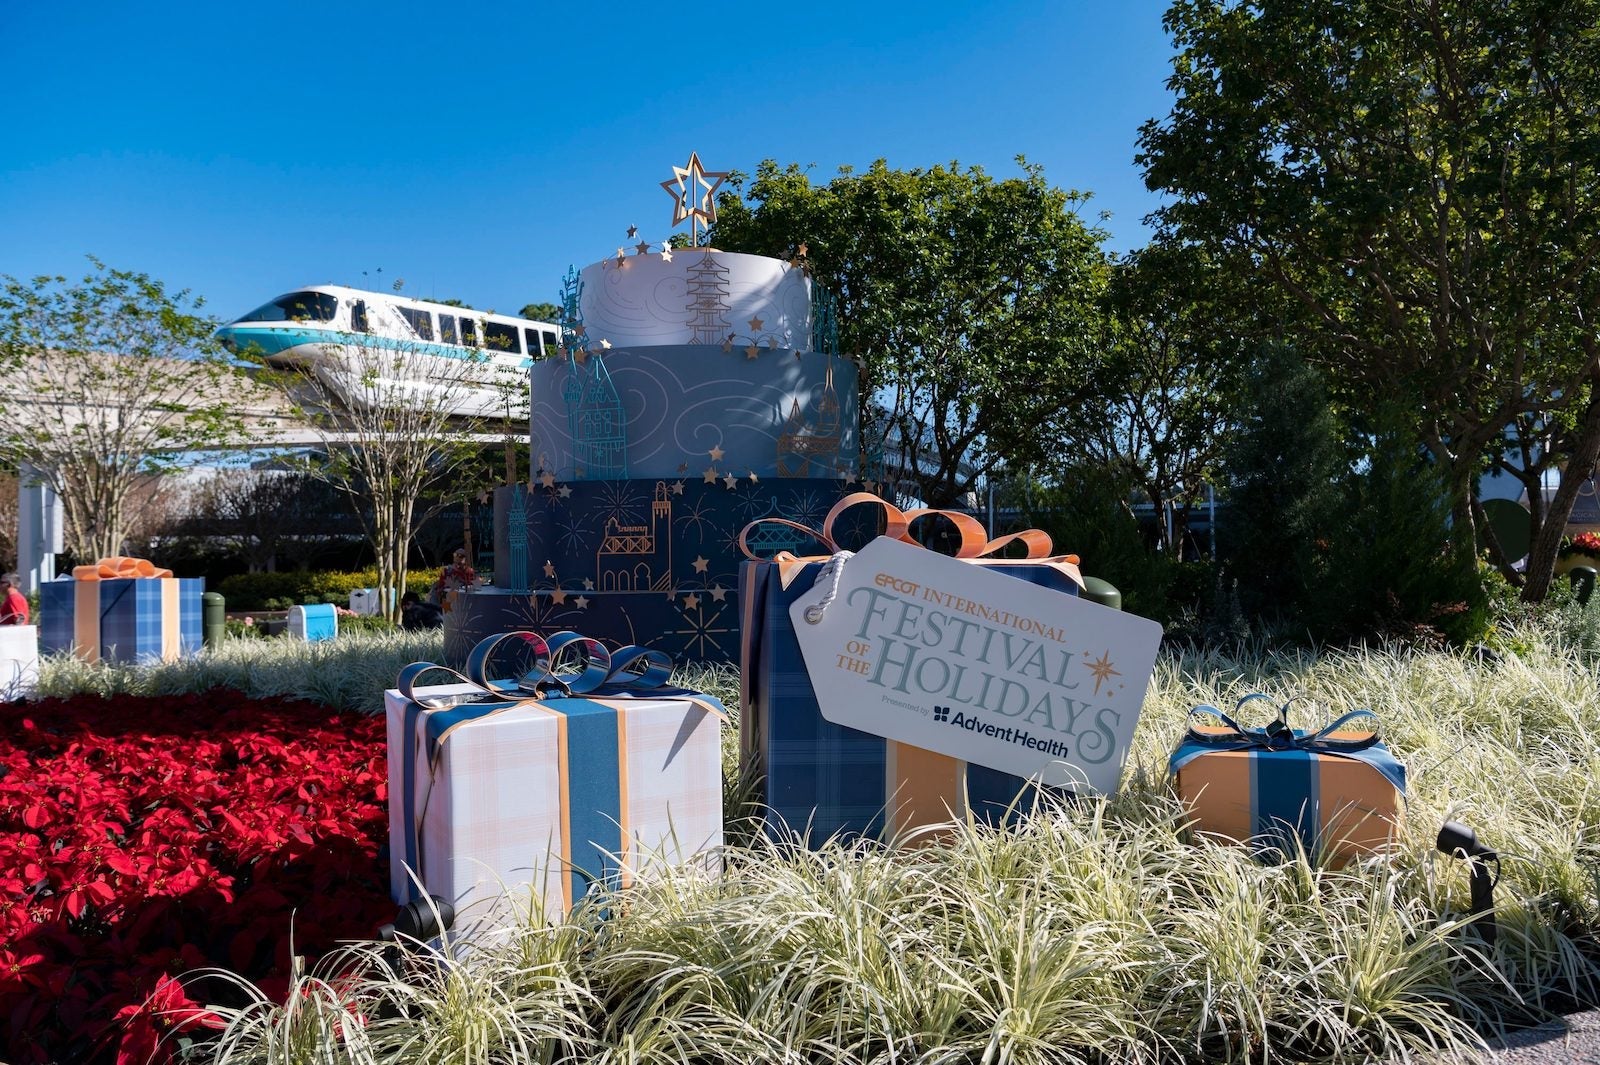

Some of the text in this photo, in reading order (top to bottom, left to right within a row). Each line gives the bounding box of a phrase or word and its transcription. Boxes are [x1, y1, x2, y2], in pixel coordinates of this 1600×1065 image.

[875, 573, 1067, 643] EPCOT INTERNATIONAL
[846, 586, 1080, 690] FESTIVAL
[846, 640, 871, 657] OF
[835, 654, 871, 676] THE
[866, 634, 1121, 765] HOLIDAYS
[881, 695, 930, 717] Presented by
[950, 711, 1069, 758] AdventHealth
